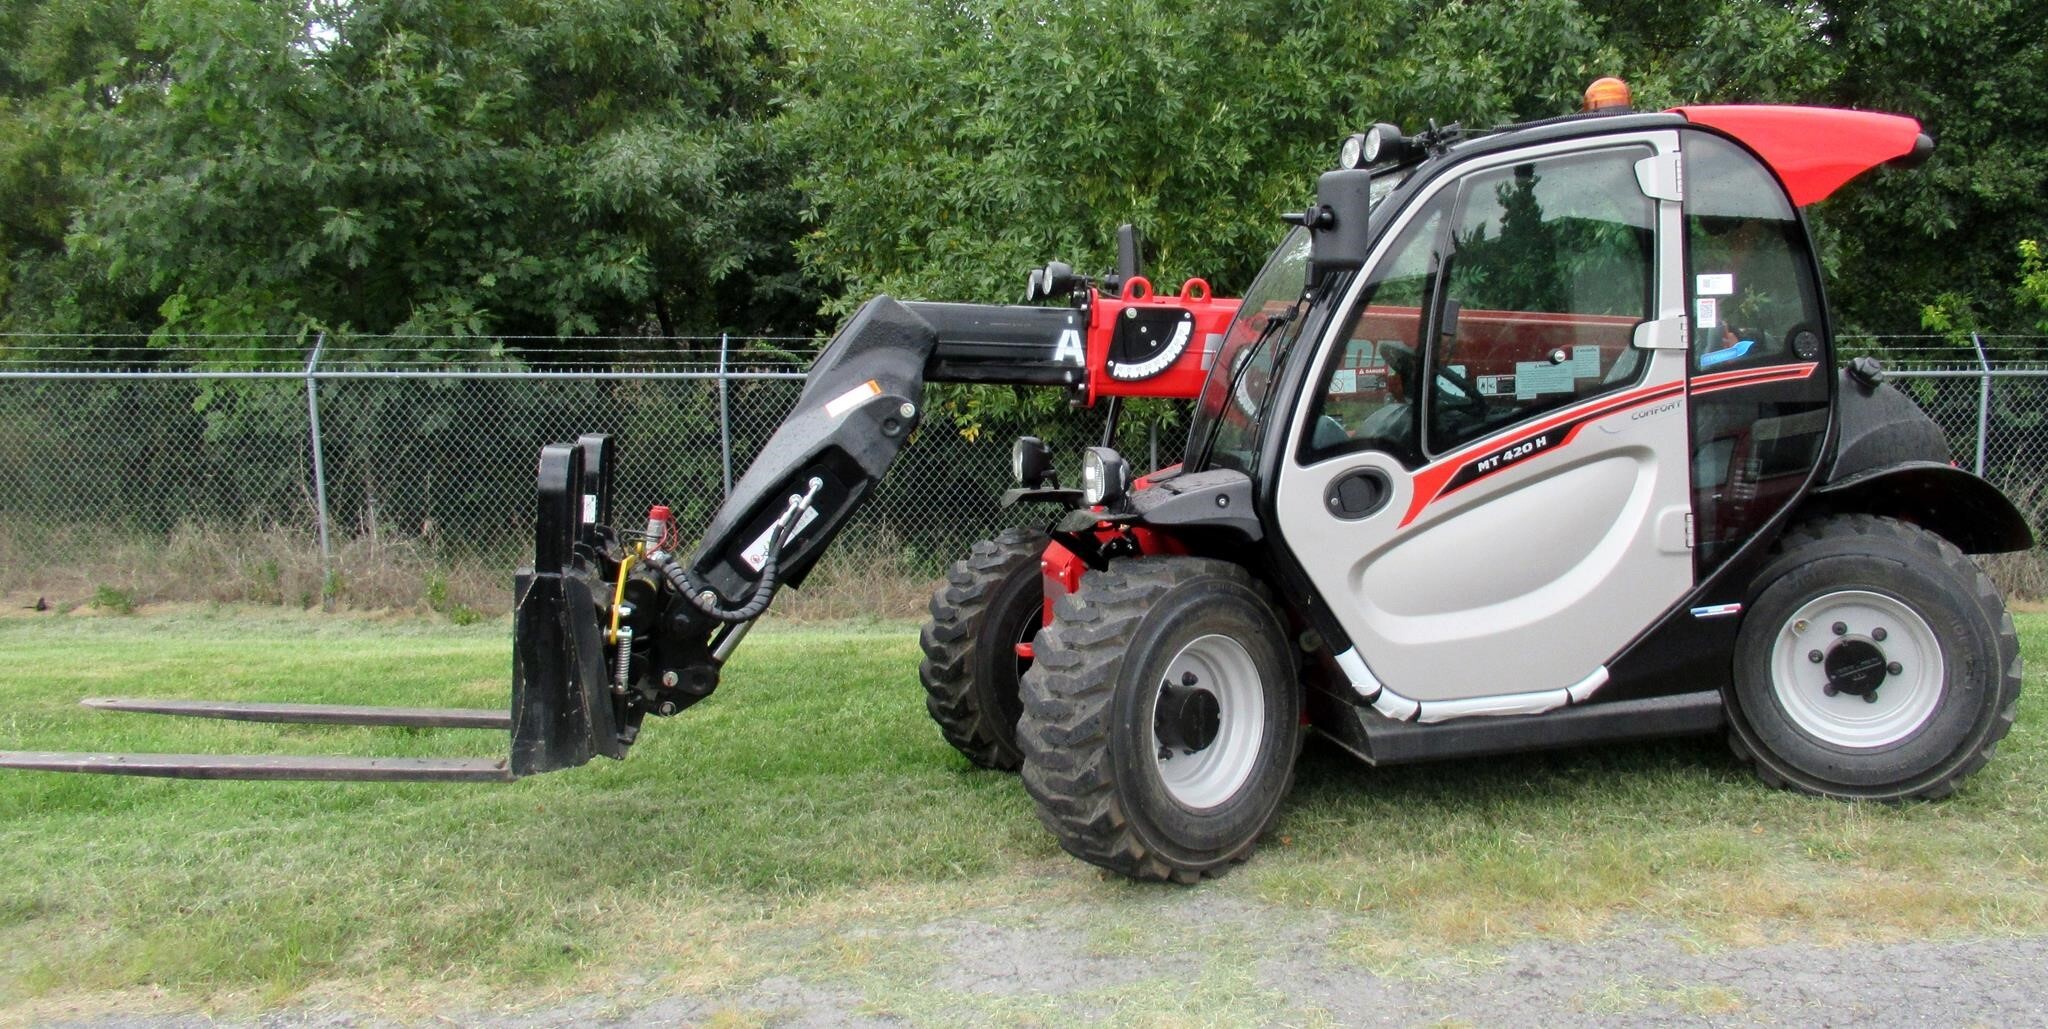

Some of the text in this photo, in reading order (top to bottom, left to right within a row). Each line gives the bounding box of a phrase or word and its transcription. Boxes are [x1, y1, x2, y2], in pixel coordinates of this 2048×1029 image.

[1053, 329, 1086, 367] A
[1477, 436, 1547, 472] MT 420 H
